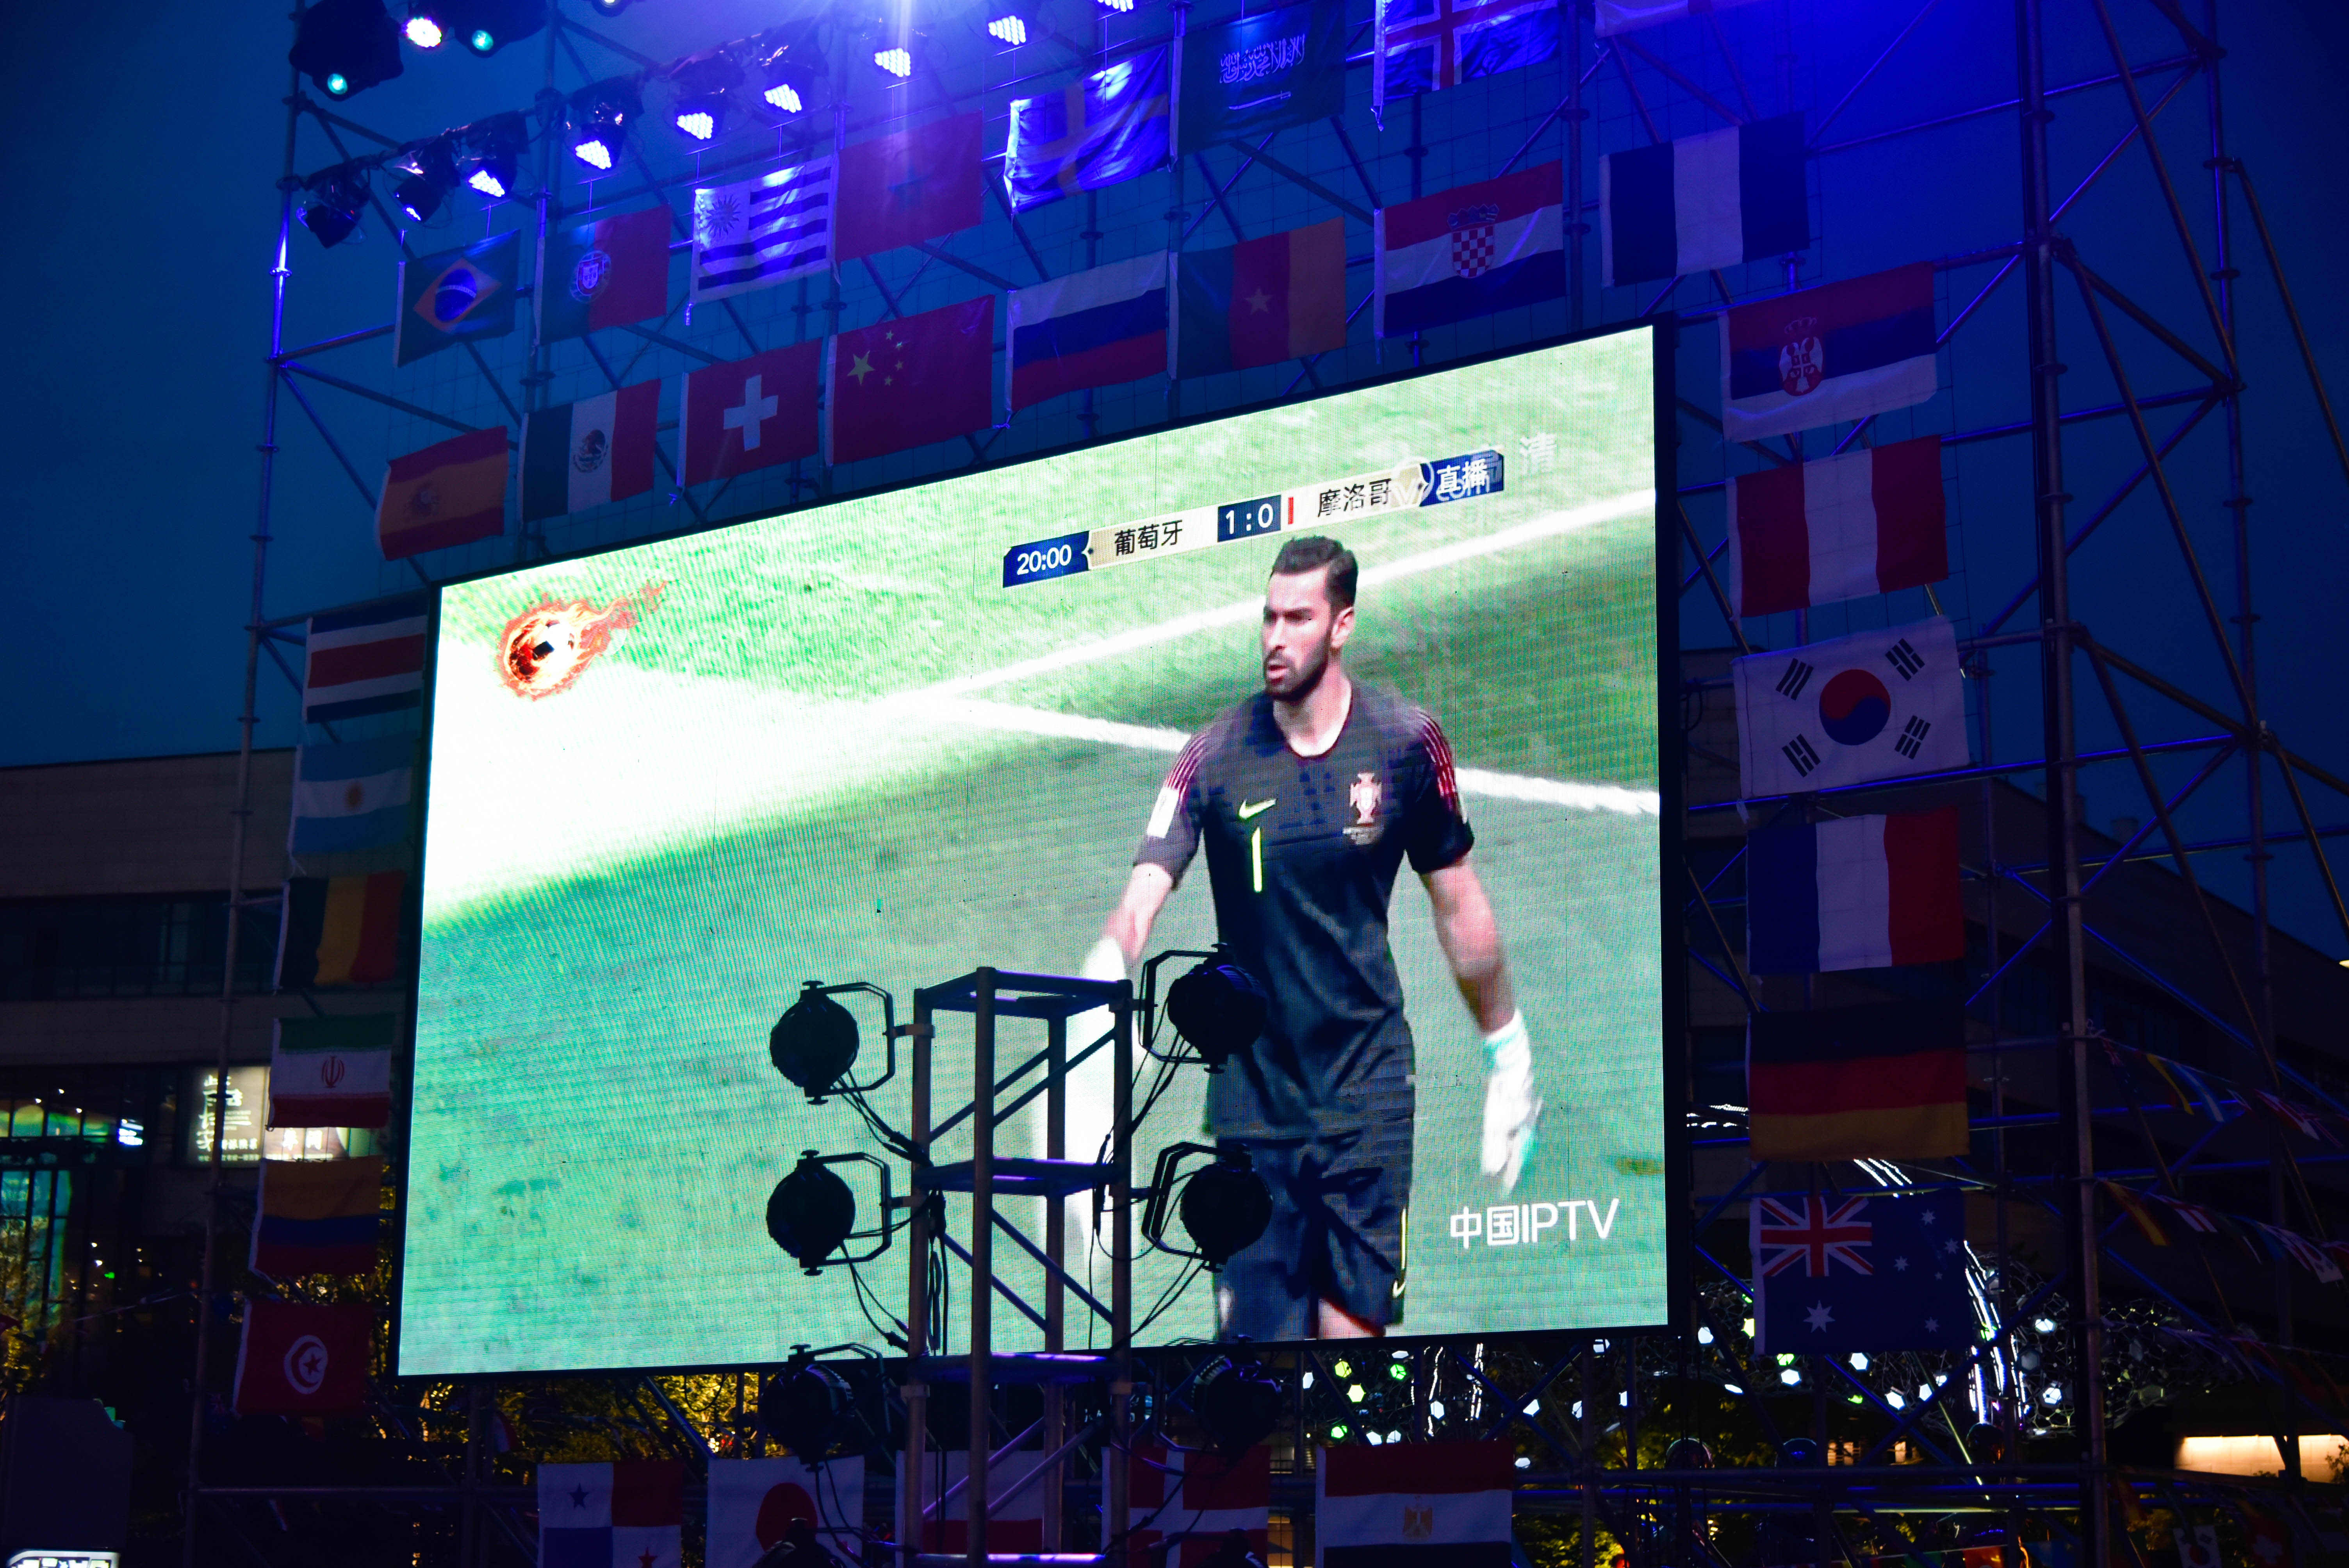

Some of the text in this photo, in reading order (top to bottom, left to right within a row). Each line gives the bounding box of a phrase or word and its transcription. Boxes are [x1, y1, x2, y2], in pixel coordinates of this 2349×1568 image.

[1436, 458, 1488, 494] 直播
[1317, 478, 1392, 518] 摩洛哥
[1114, 519, 1183, 556] 葡萄牙
[1016, 544, 1072, 575] 20:00
